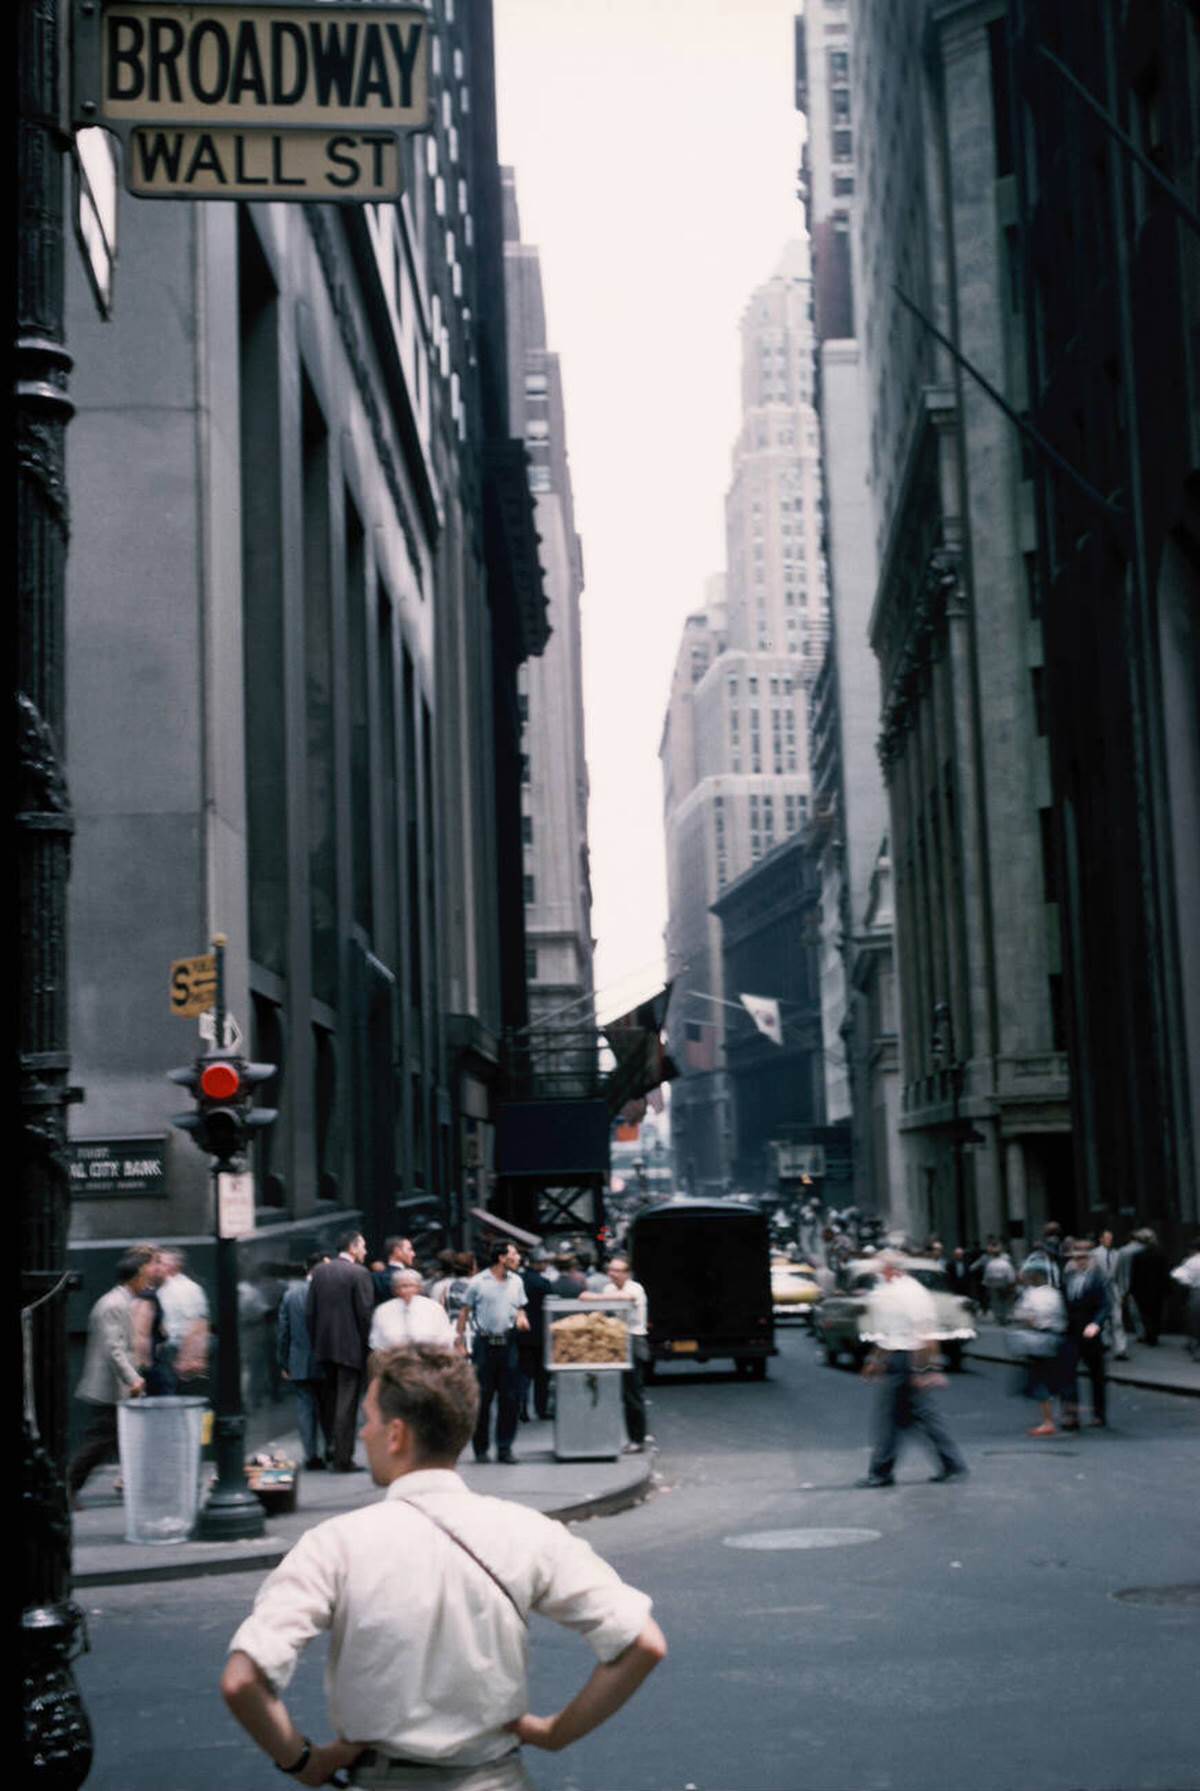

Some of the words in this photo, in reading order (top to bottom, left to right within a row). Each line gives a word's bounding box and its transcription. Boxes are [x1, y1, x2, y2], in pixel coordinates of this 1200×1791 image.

[107, 16, 422, 108] BROADWAY
[137, 132, 306, 186] WALL
[325, 136, 396, 188] ST
[89, 1160, 120, 1177] CITY
[123, 1159, 162, 1177] BANK
